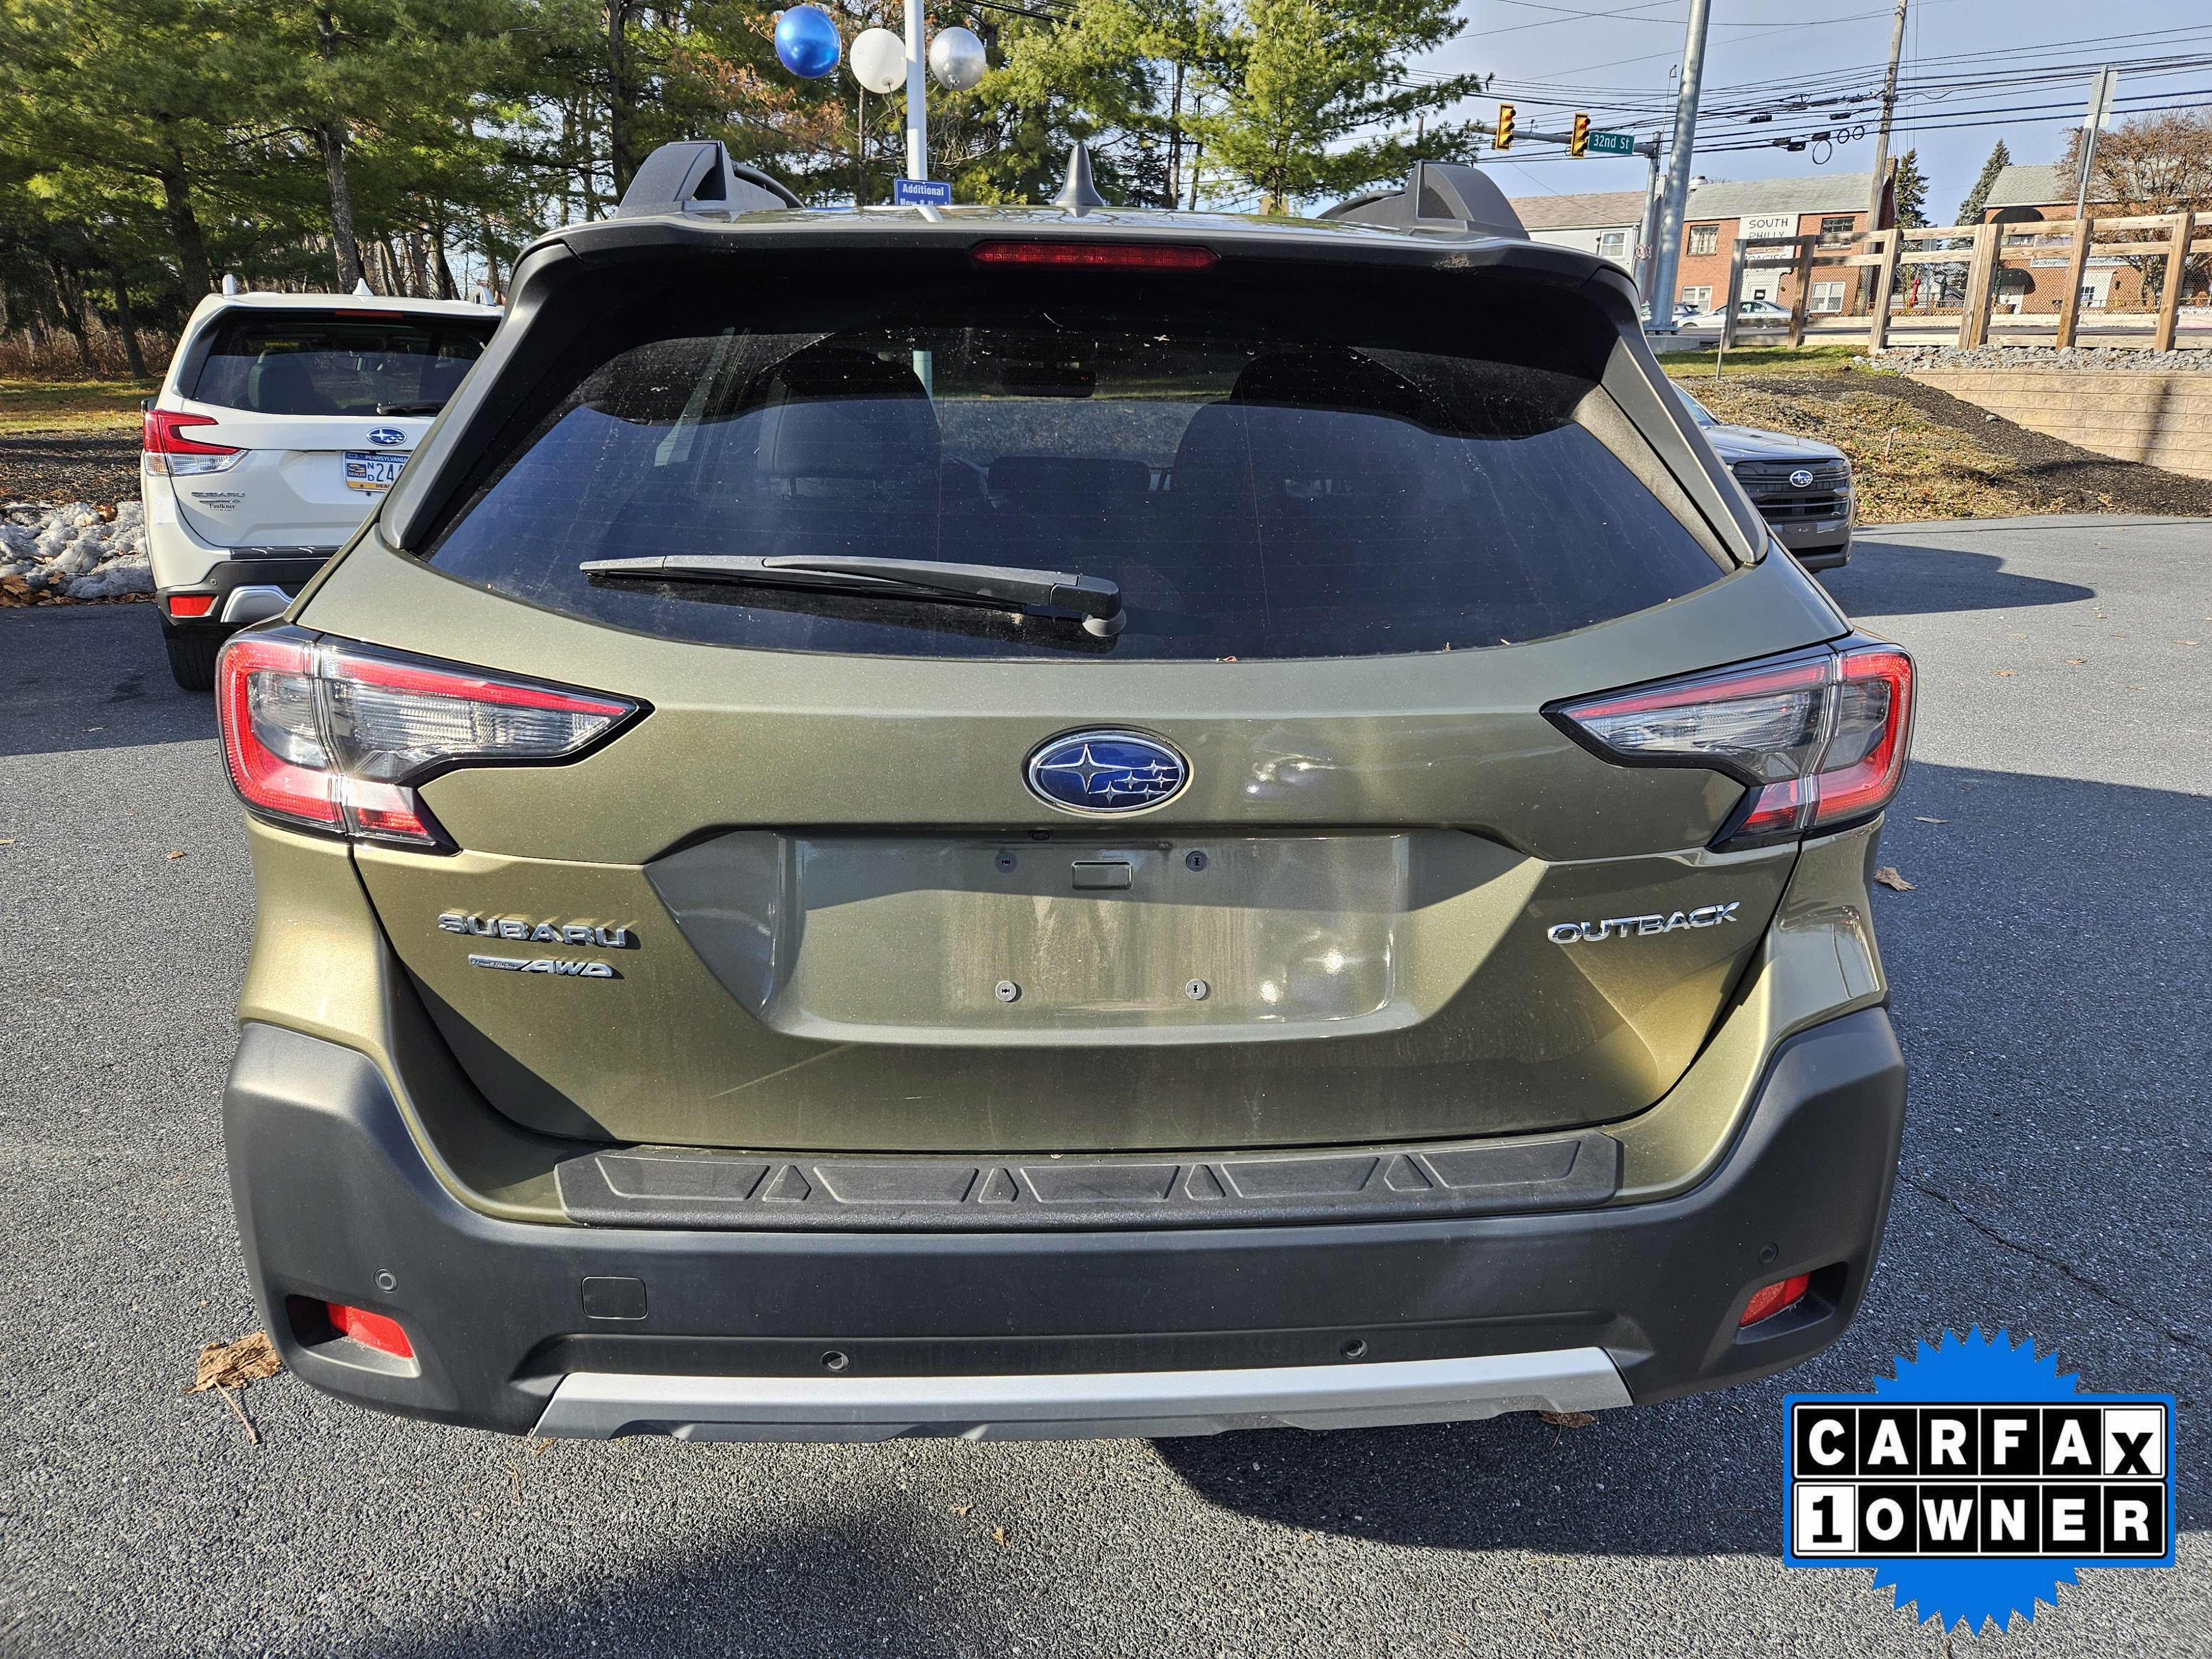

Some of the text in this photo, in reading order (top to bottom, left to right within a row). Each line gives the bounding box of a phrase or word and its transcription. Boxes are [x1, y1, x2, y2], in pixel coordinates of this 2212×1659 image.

[1593, 134, 1629, 149] 32nd St
[902, 183, 944, 196] Additional
[1749, 218, 1788, 229] SOUTH
[376, 463, 403, 482] 24
[437, 913, 628, 947] SUBARU
[1547, 901, 1740, 944] OUTBACK
[521, 959, 613, 977] AWD
